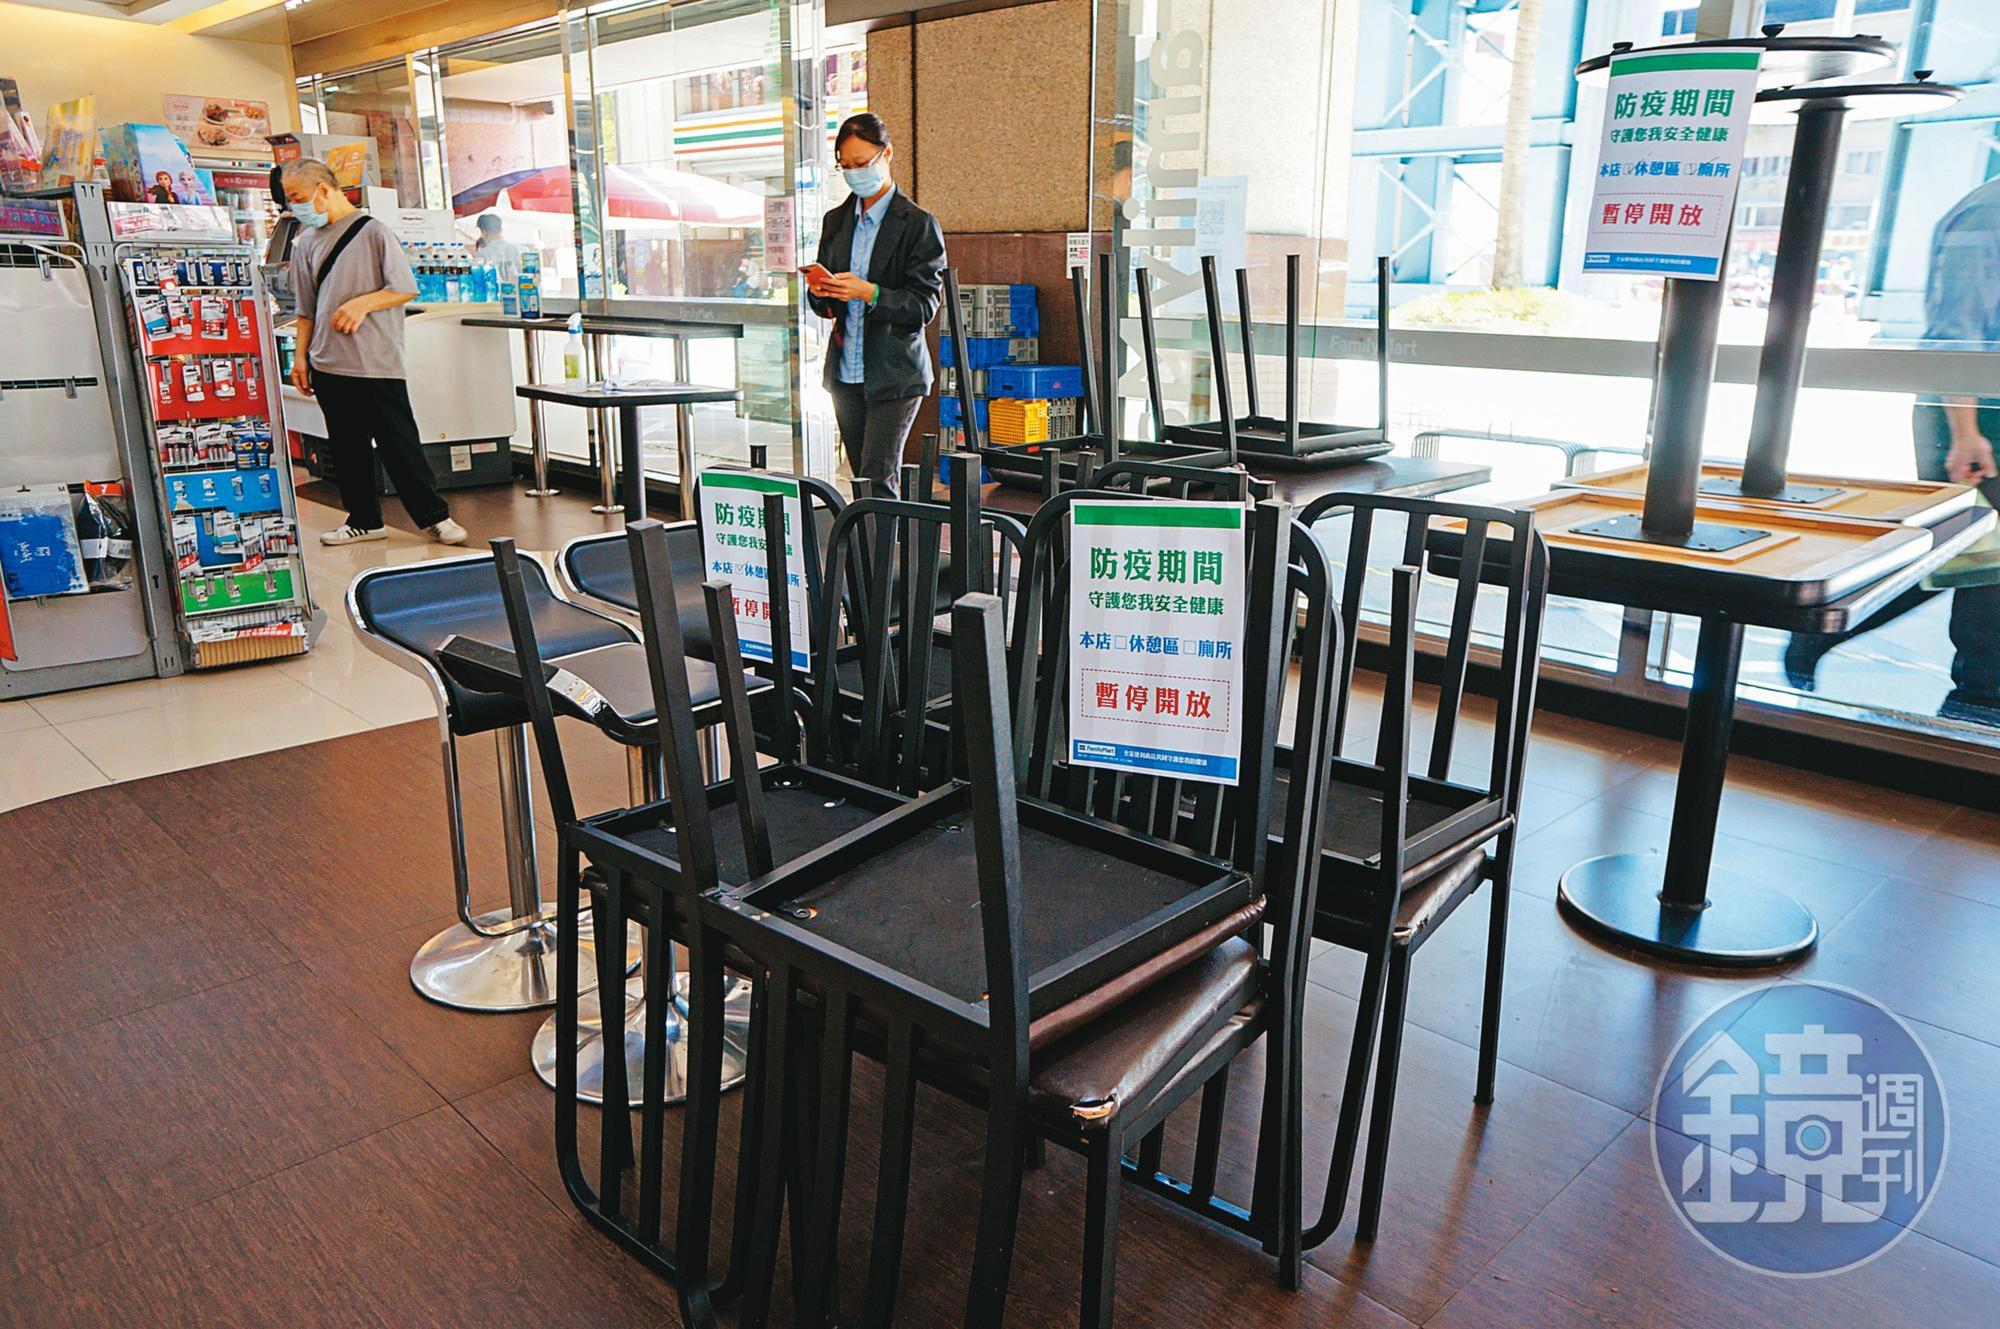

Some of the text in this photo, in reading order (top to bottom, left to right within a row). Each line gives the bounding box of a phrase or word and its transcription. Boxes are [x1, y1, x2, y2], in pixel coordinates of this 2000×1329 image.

[1614, 89, 1735, 120] 防疫期間
[1610, 126, 1730, 144] 守護您我安全健康
[1600, 163, 1621, 177] 本店
[1634, 161, 1680, 177] 休憩區
[1602, 202, 1703, 226] 暫停開放
[716, 533, 793, 556] 守護您我安康
[712, 560, 733, 576] 本店
[1090, 547, 1223, 585] 防疫期間
[1088, 590, 1224, 616] 守護您我安全健康
[1080, 631, 1111, 651] 本店
[1129, 634, 1179, 656] 休憩區
[1095, 681, 1211, 718] 暫停開放
[1086, 745, 1115, 756] FamilyMart
